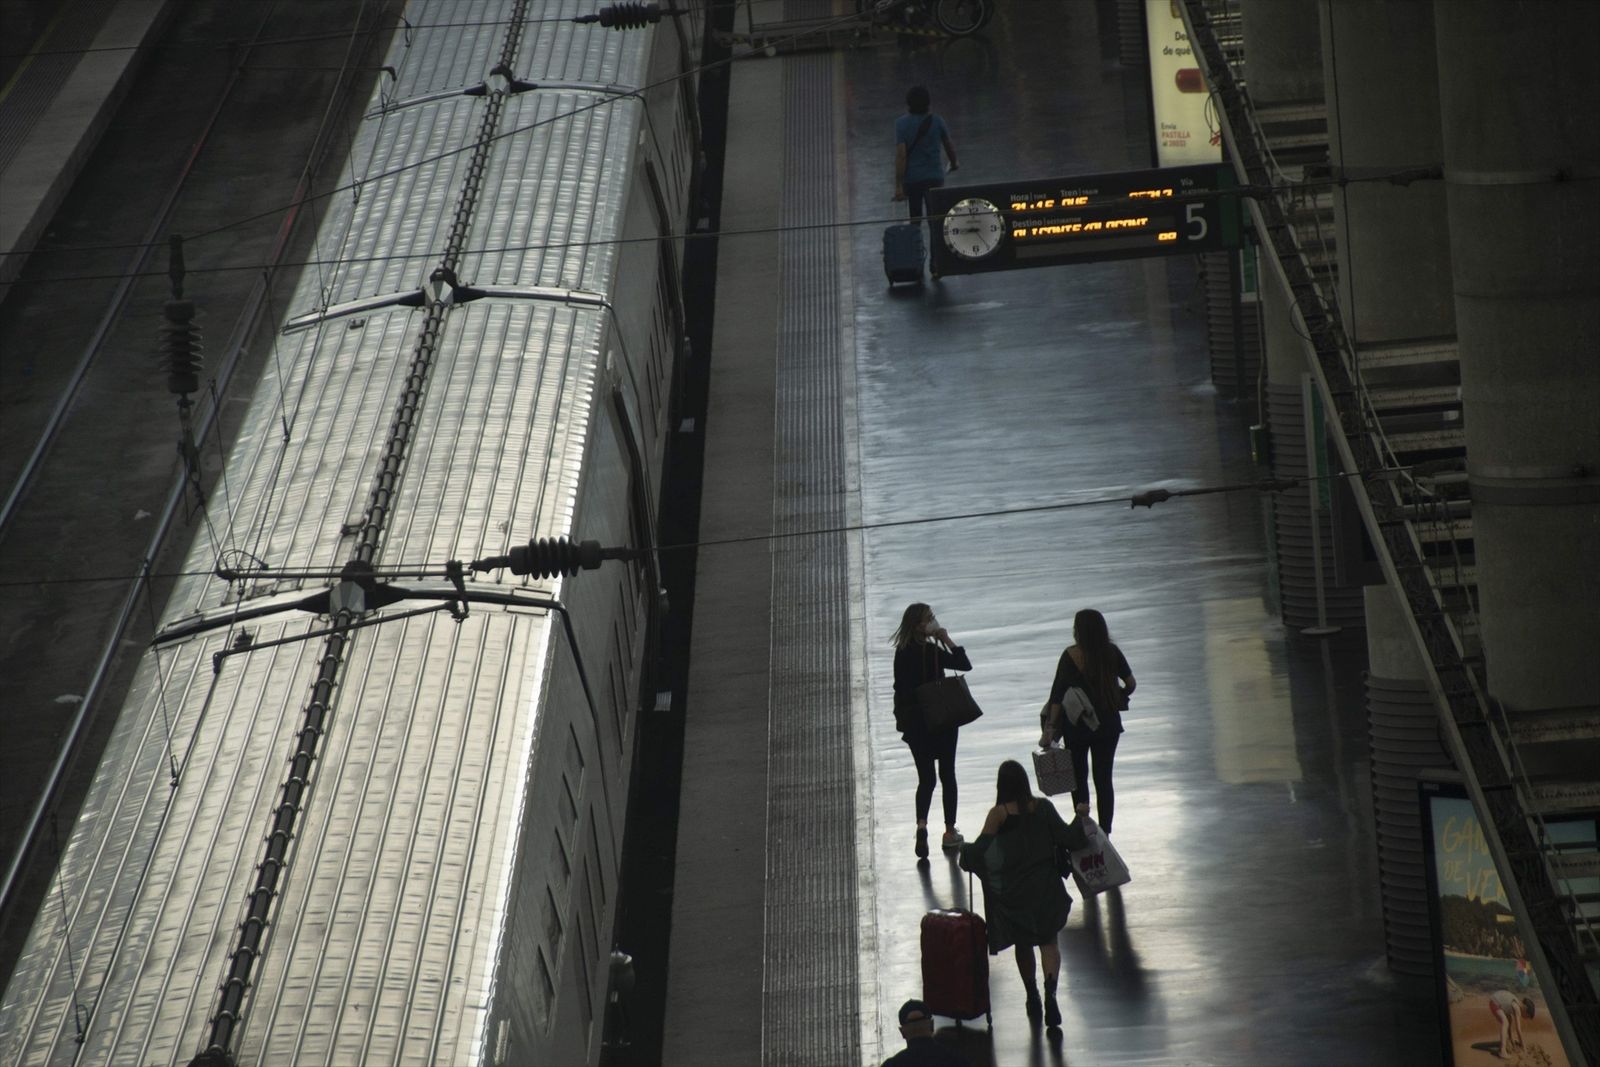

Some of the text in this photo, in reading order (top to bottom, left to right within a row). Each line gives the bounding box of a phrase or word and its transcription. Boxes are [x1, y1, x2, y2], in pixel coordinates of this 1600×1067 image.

[1163, 45, 1173, 55] de
[1162, 130, 1191, 139] PASTILLA
[1010, 193, 1029, 202] Hora
[1060, 188, 1078, 197] Tren
[1012, 218, 1043, 228] Destino
[1186, 203, 1208, 240] 5
[990, 224, 997, 232] 3
[1444, 859, 1465, 883] DE
